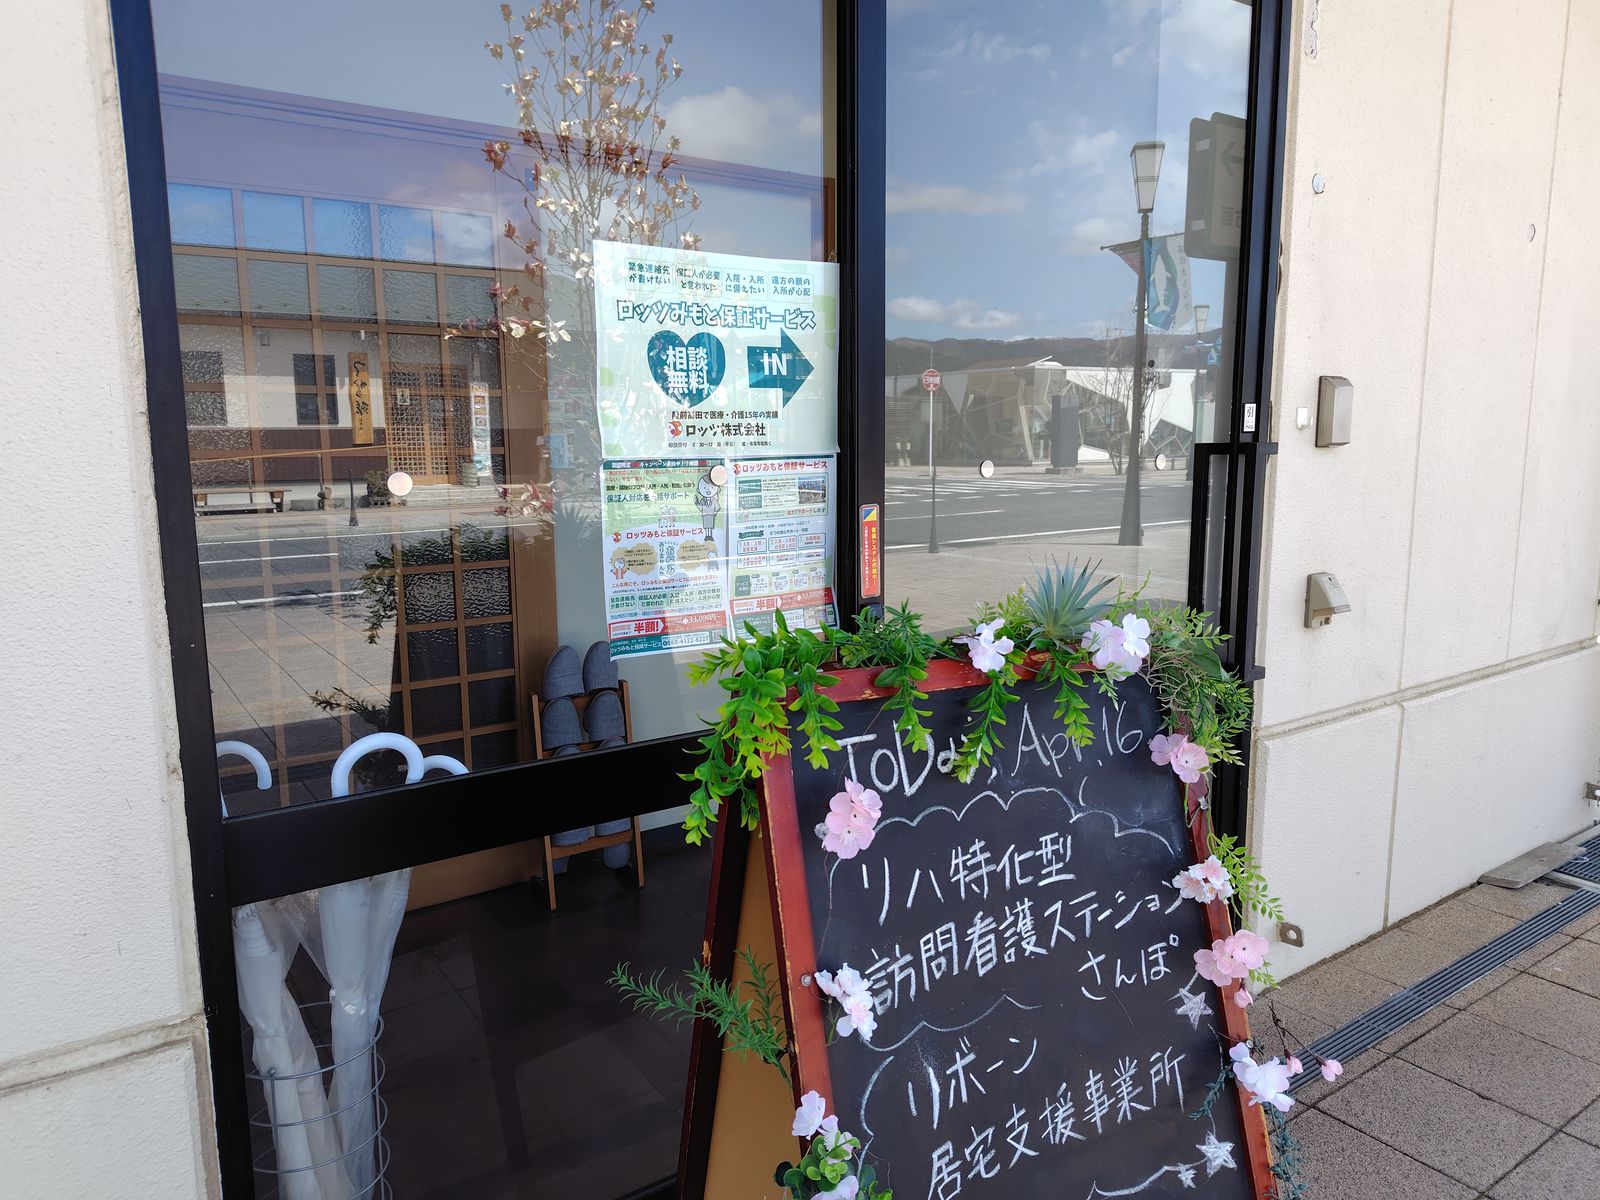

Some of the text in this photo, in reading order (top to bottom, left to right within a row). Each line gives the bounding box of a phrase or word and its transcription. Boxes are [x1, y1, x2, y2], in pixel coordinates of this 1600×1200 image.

[628, 273, 671, 285] が書けない
[725, 272, 765, 284] 入院・入所
[725, 284, 765, 294] に備えたい
[771, 275, 811, 286] 遠方の親の
[772, 286, 811, 297] 入所が心配
[616, 299, 817, 330] ロッツみもと保証サービス
[666, 345, 708, 371] 相談
[763, 352, 788, 376] IN
[664, 368, 709, 397] 無料
[686, 422, 767, 437] ロッツ株式会社
[862, 832, 1076, 926] リハ特化型
[864, 880, 1183, 1016] 訪問看護ステーション
[1078, 933, 1180, 1001] さんぽ
[907, 1036, 1038, 1130] リボーン
[927, 1046, 1186, 1200] 居宅支援事業所
